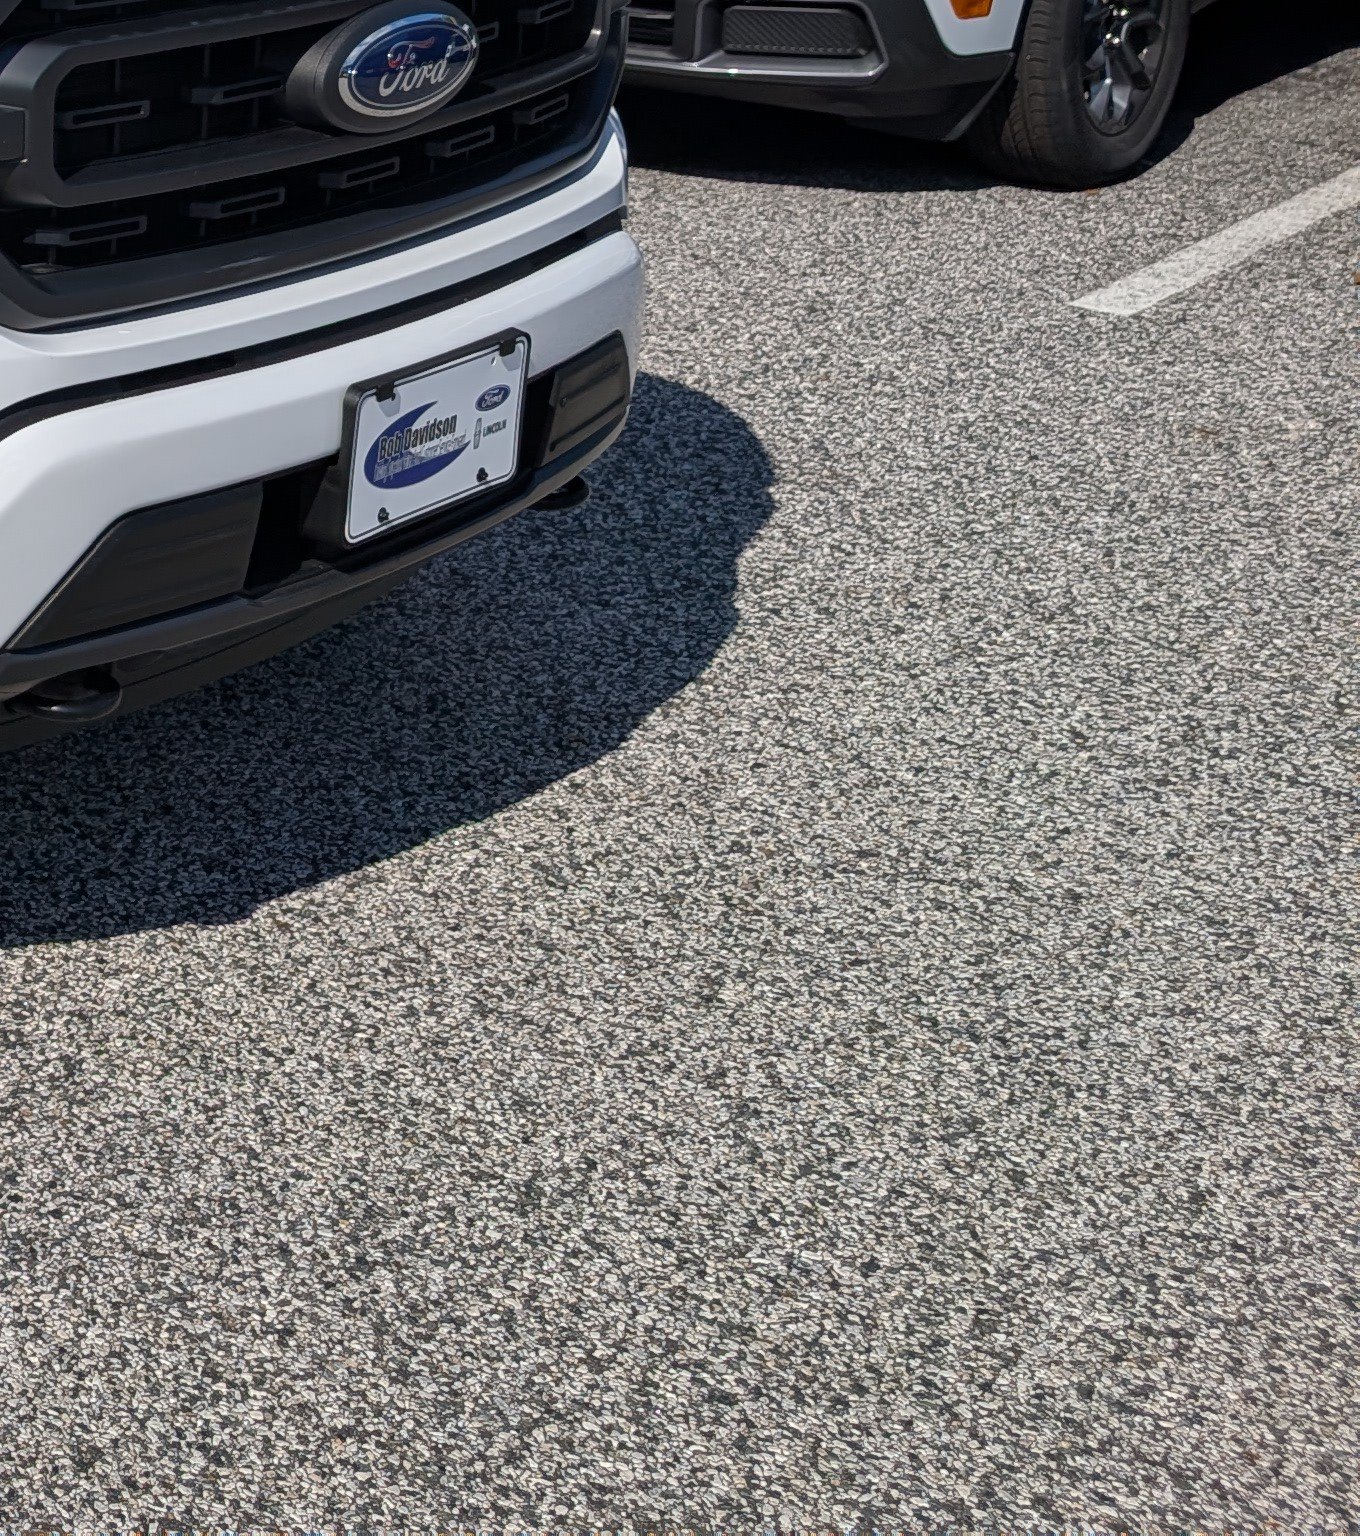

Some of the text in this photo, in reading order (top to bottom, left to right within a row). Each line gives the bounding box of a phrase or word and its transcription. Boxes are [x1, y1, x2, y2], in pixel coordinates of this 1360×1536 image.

[379, 36, 455, 98] Ford
[378, 435, 404, 462] Bob
[403, 413, 458, 452] Davidson
[482, 418, 507, 438] LINCOLN
